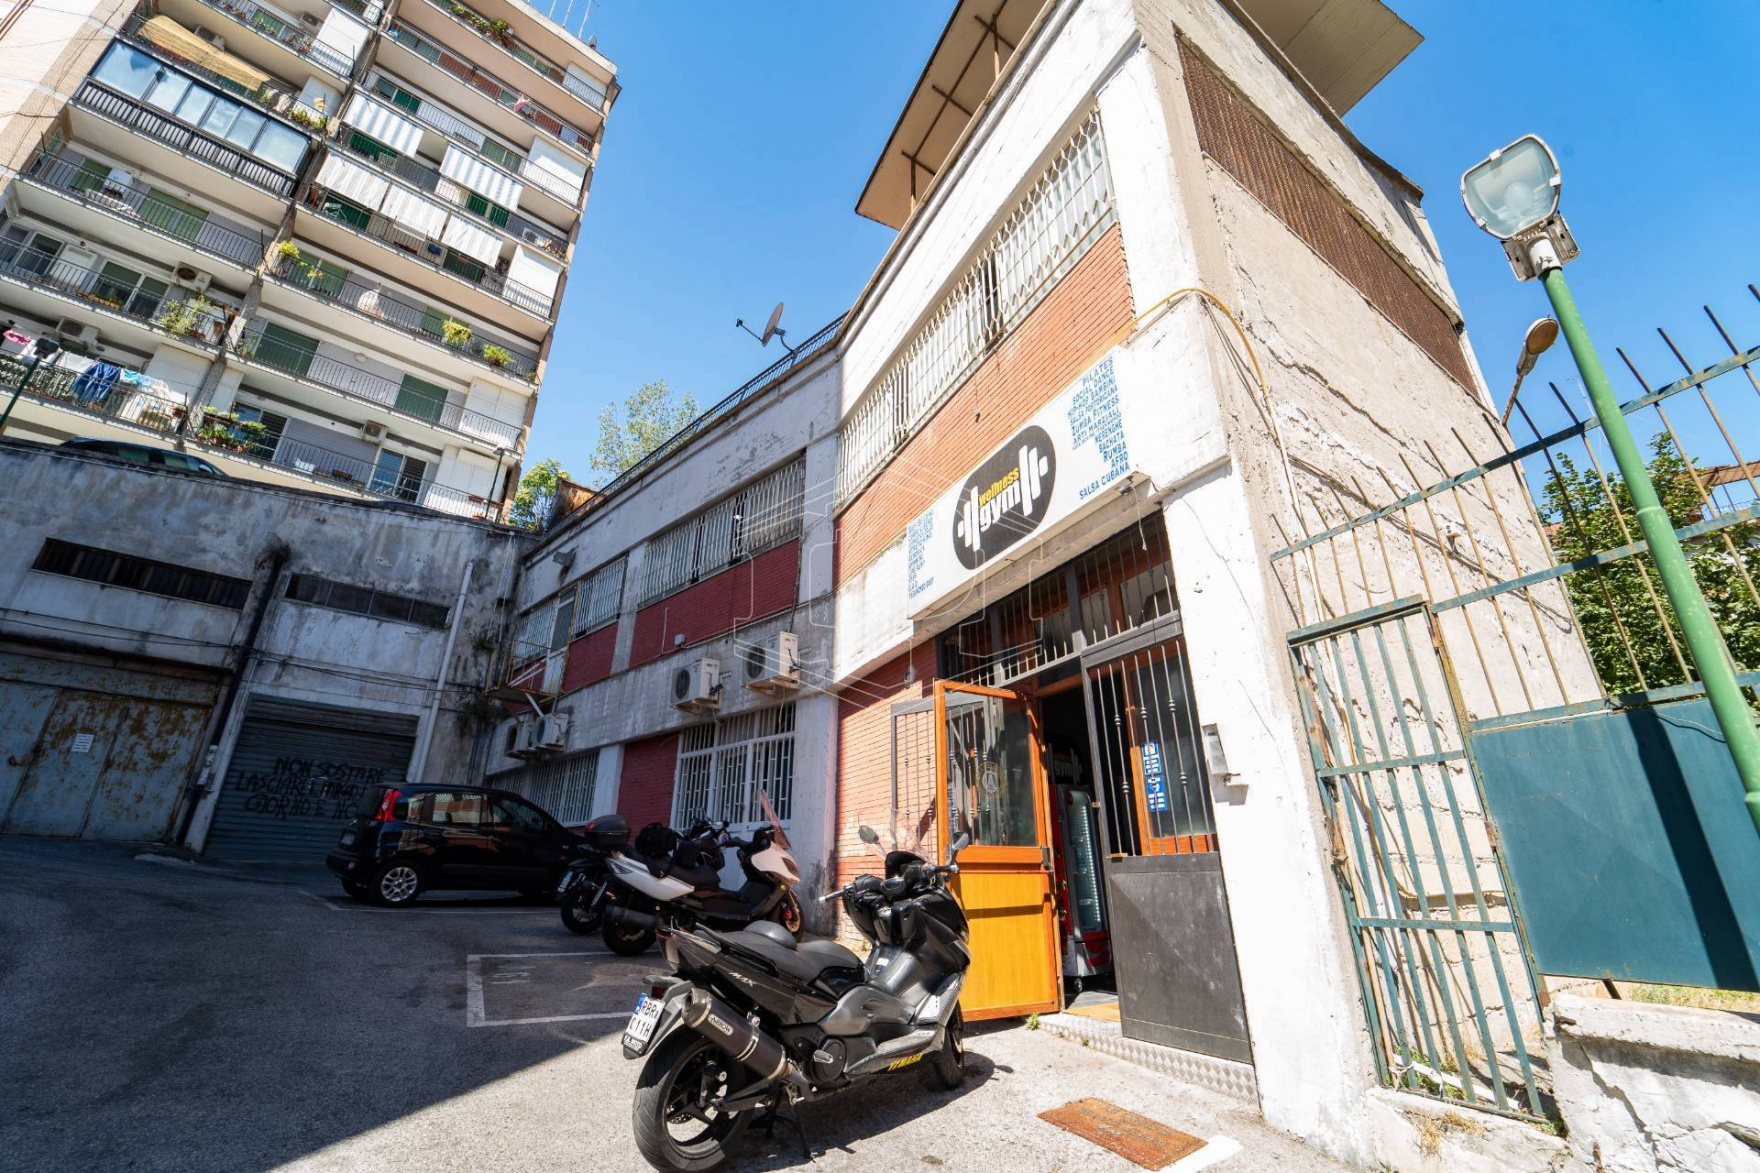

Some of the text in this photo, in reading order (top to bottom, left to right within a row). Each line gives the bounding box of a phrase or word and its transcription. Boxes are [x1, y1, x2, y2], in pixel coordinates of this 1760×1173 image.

[1072, 365, 1115, 406] SOCIAL DANCE
[1082, 356, 1113, 387] PILATES
[1072, 415, 1091, 437] ZUMBA
[1093, 394, 1119, 420] FITNESS
[1088, 406, 1119, 433] MARZIALI
[1099, 430, 1124, 453] BACHATA
[1103, 441, 1127, 462] RUMBA
[1111, 451, 1129, 469] AFRO
[979, 467, 1019, 507] wellness
[1079, 461, 1130, 500] SALSA CUBANA
[979, 479, 1021, 532] gym
[273, 756, 386, 784] NON SOSTARE
